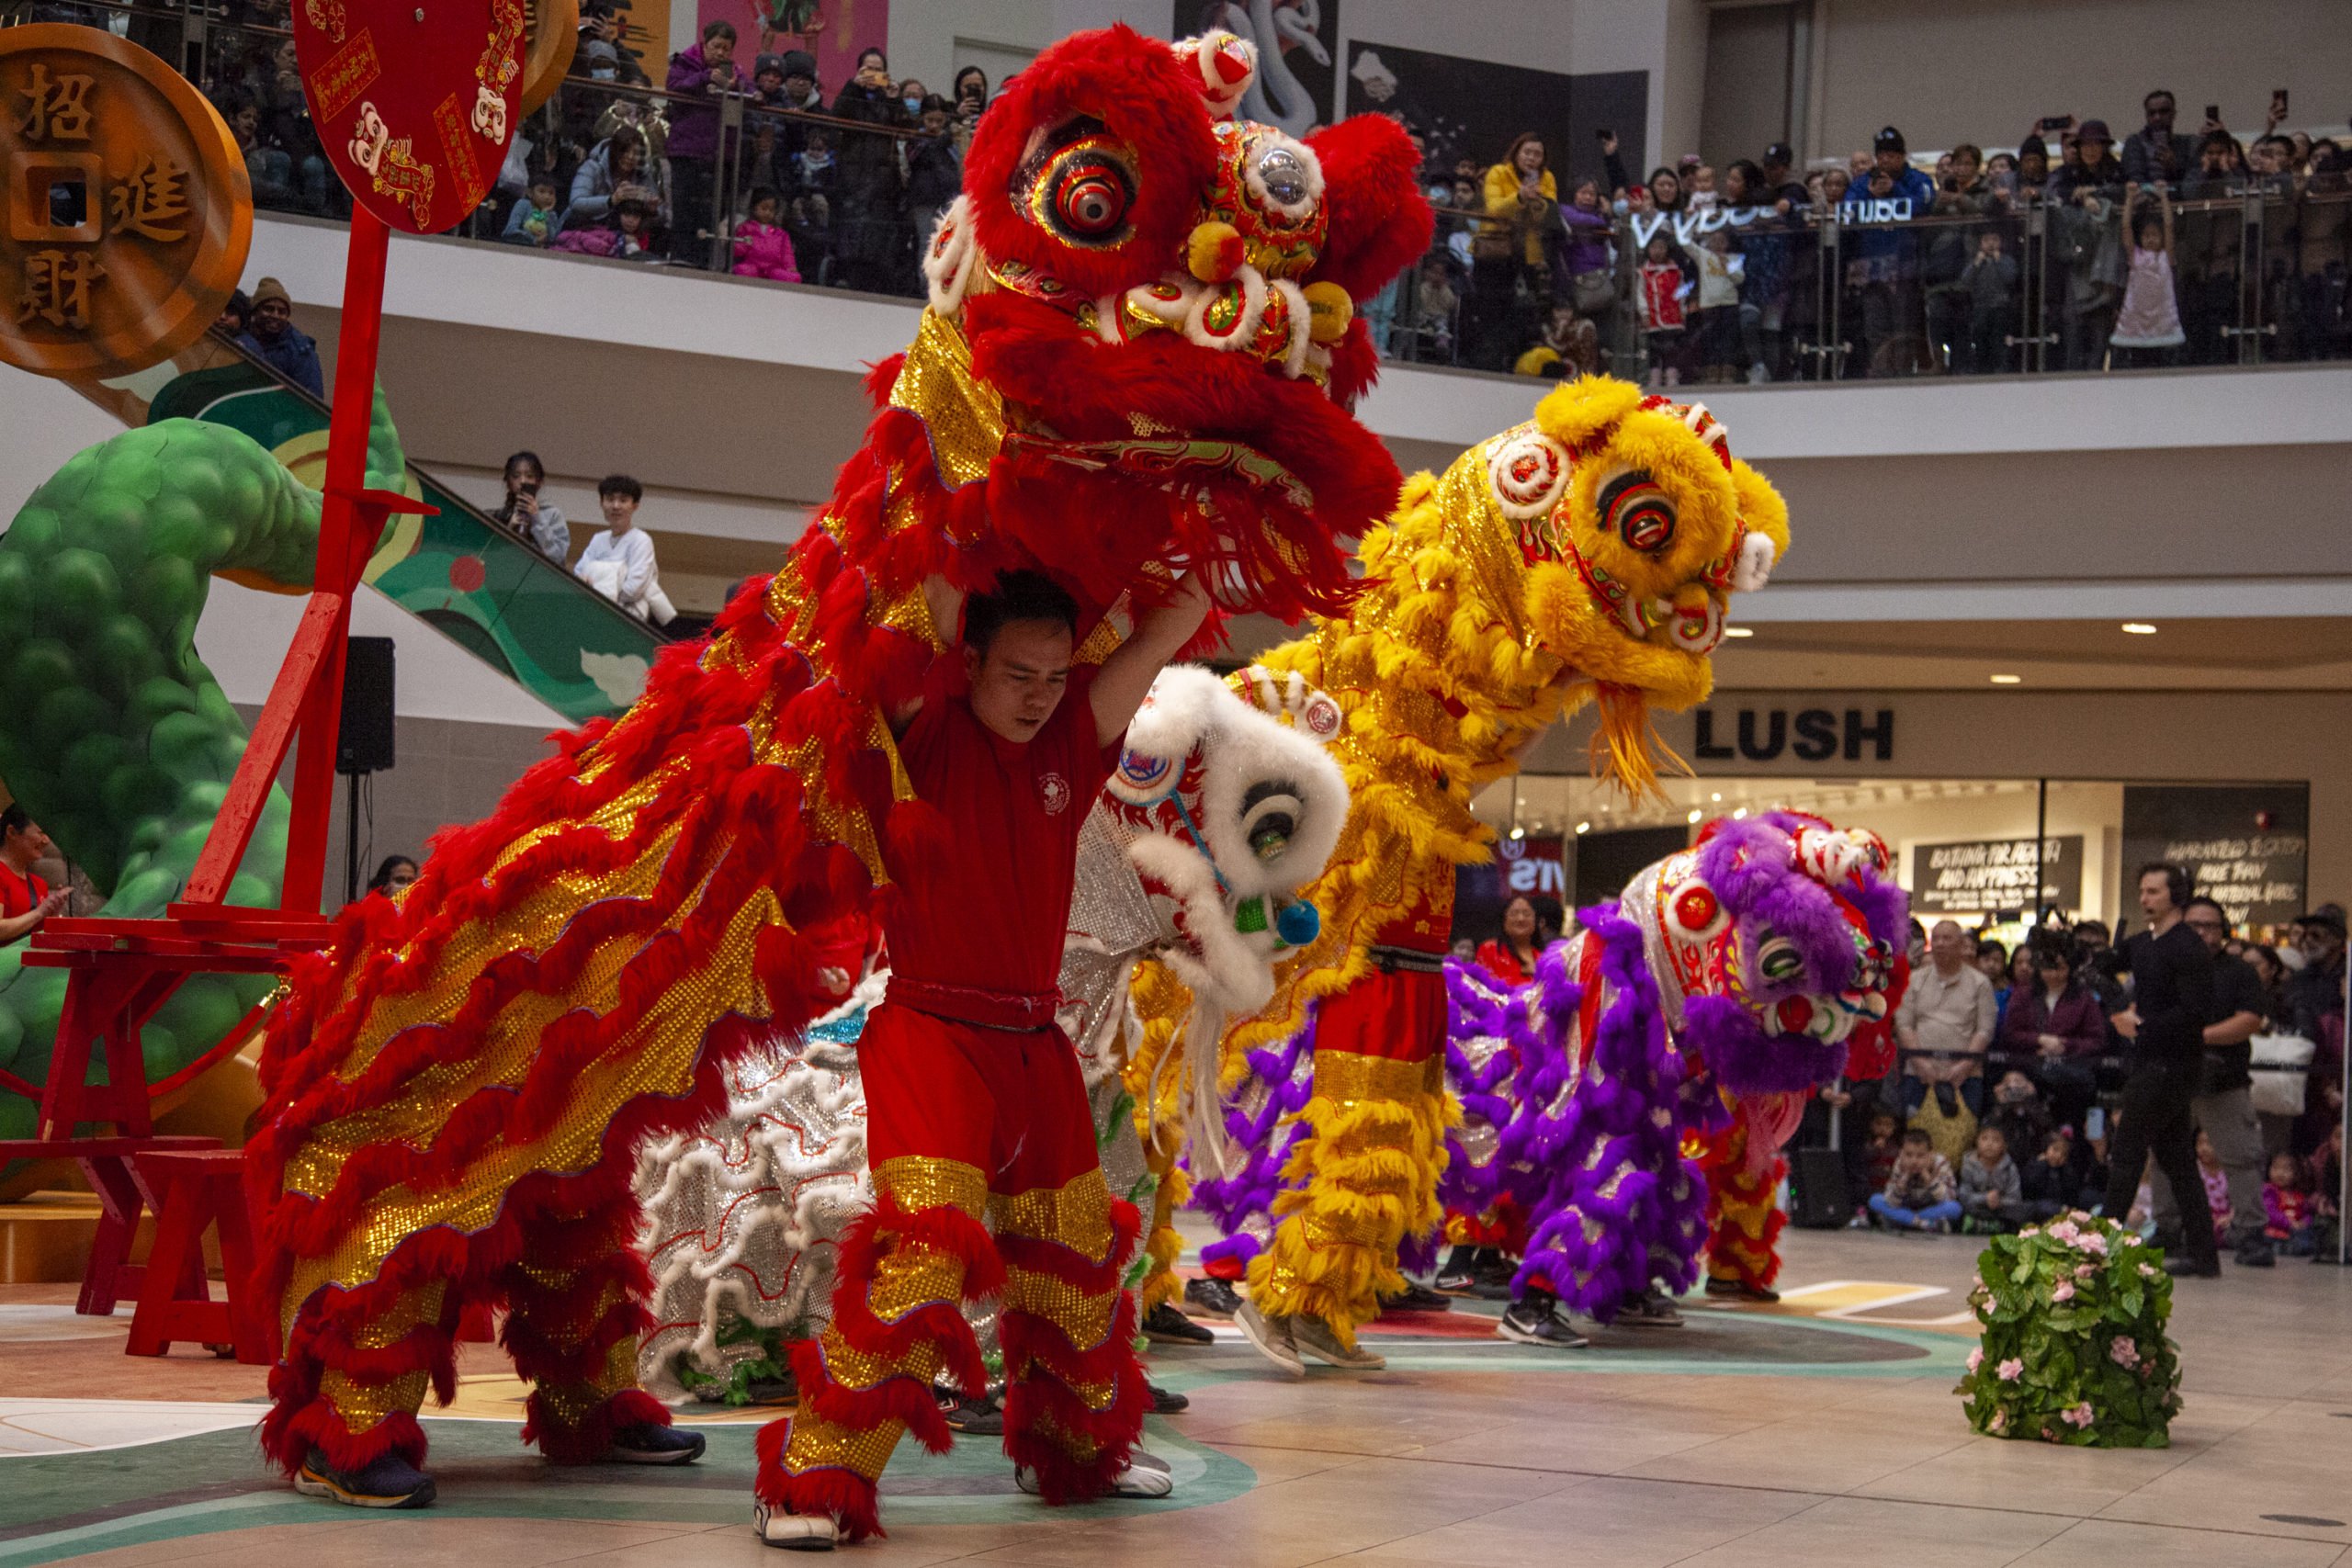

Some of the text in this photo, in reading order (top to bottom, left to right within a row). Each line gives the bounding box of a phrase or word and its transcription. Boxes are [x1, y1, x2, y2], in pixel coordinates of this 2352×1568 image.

[16, 63, 95, 141] 招
[110, 156, 191, 243] 進
[17, 250, 107, 330] 財
[1696, 709, 1894, 761] LUSH
[1936, 867, 1966, 889] AND
